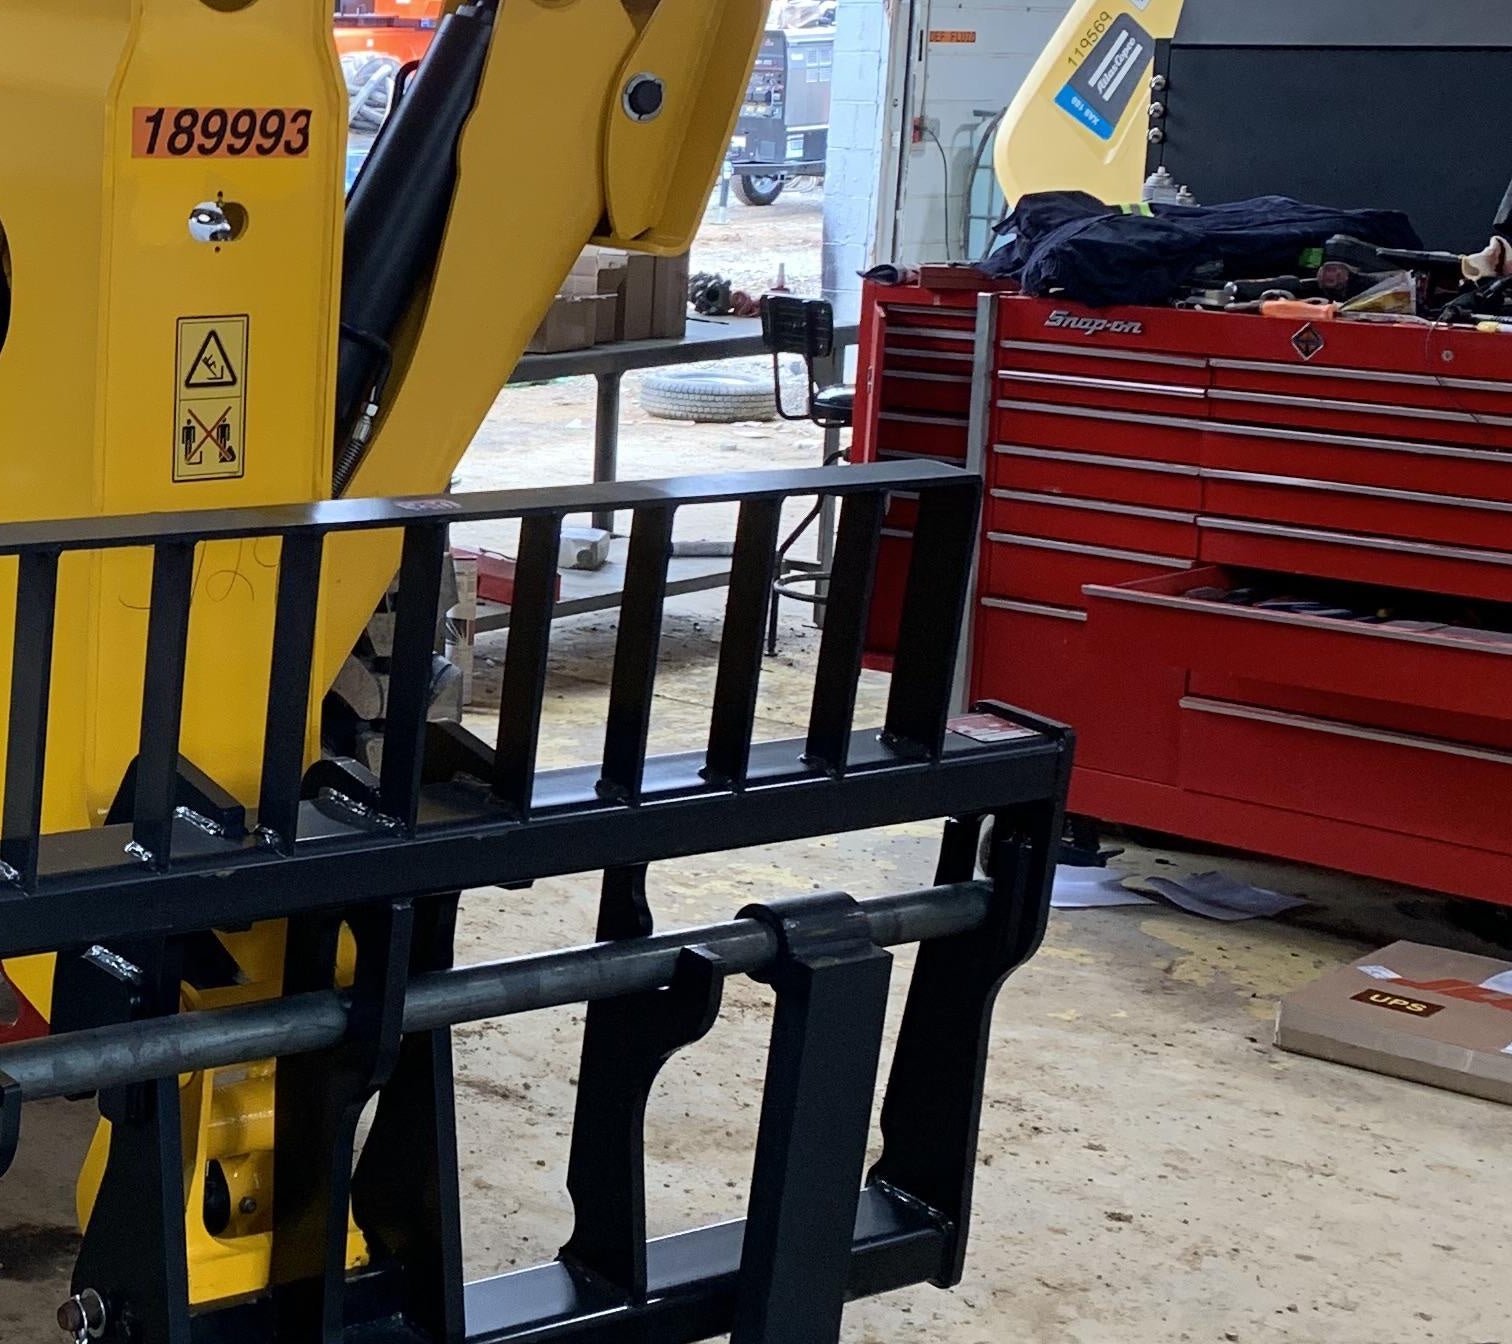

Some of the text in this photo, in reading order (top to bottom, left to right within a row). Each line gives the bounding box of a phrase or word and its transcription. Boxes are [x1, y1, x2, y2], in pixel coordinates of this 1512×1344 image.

[1068, 11, 1113, 68] 119569
[145, 108, 313, 156] 189993
[1044, 309, 1143, 336] Snap-on
[1369, 994, 1428, 1012] UPS
